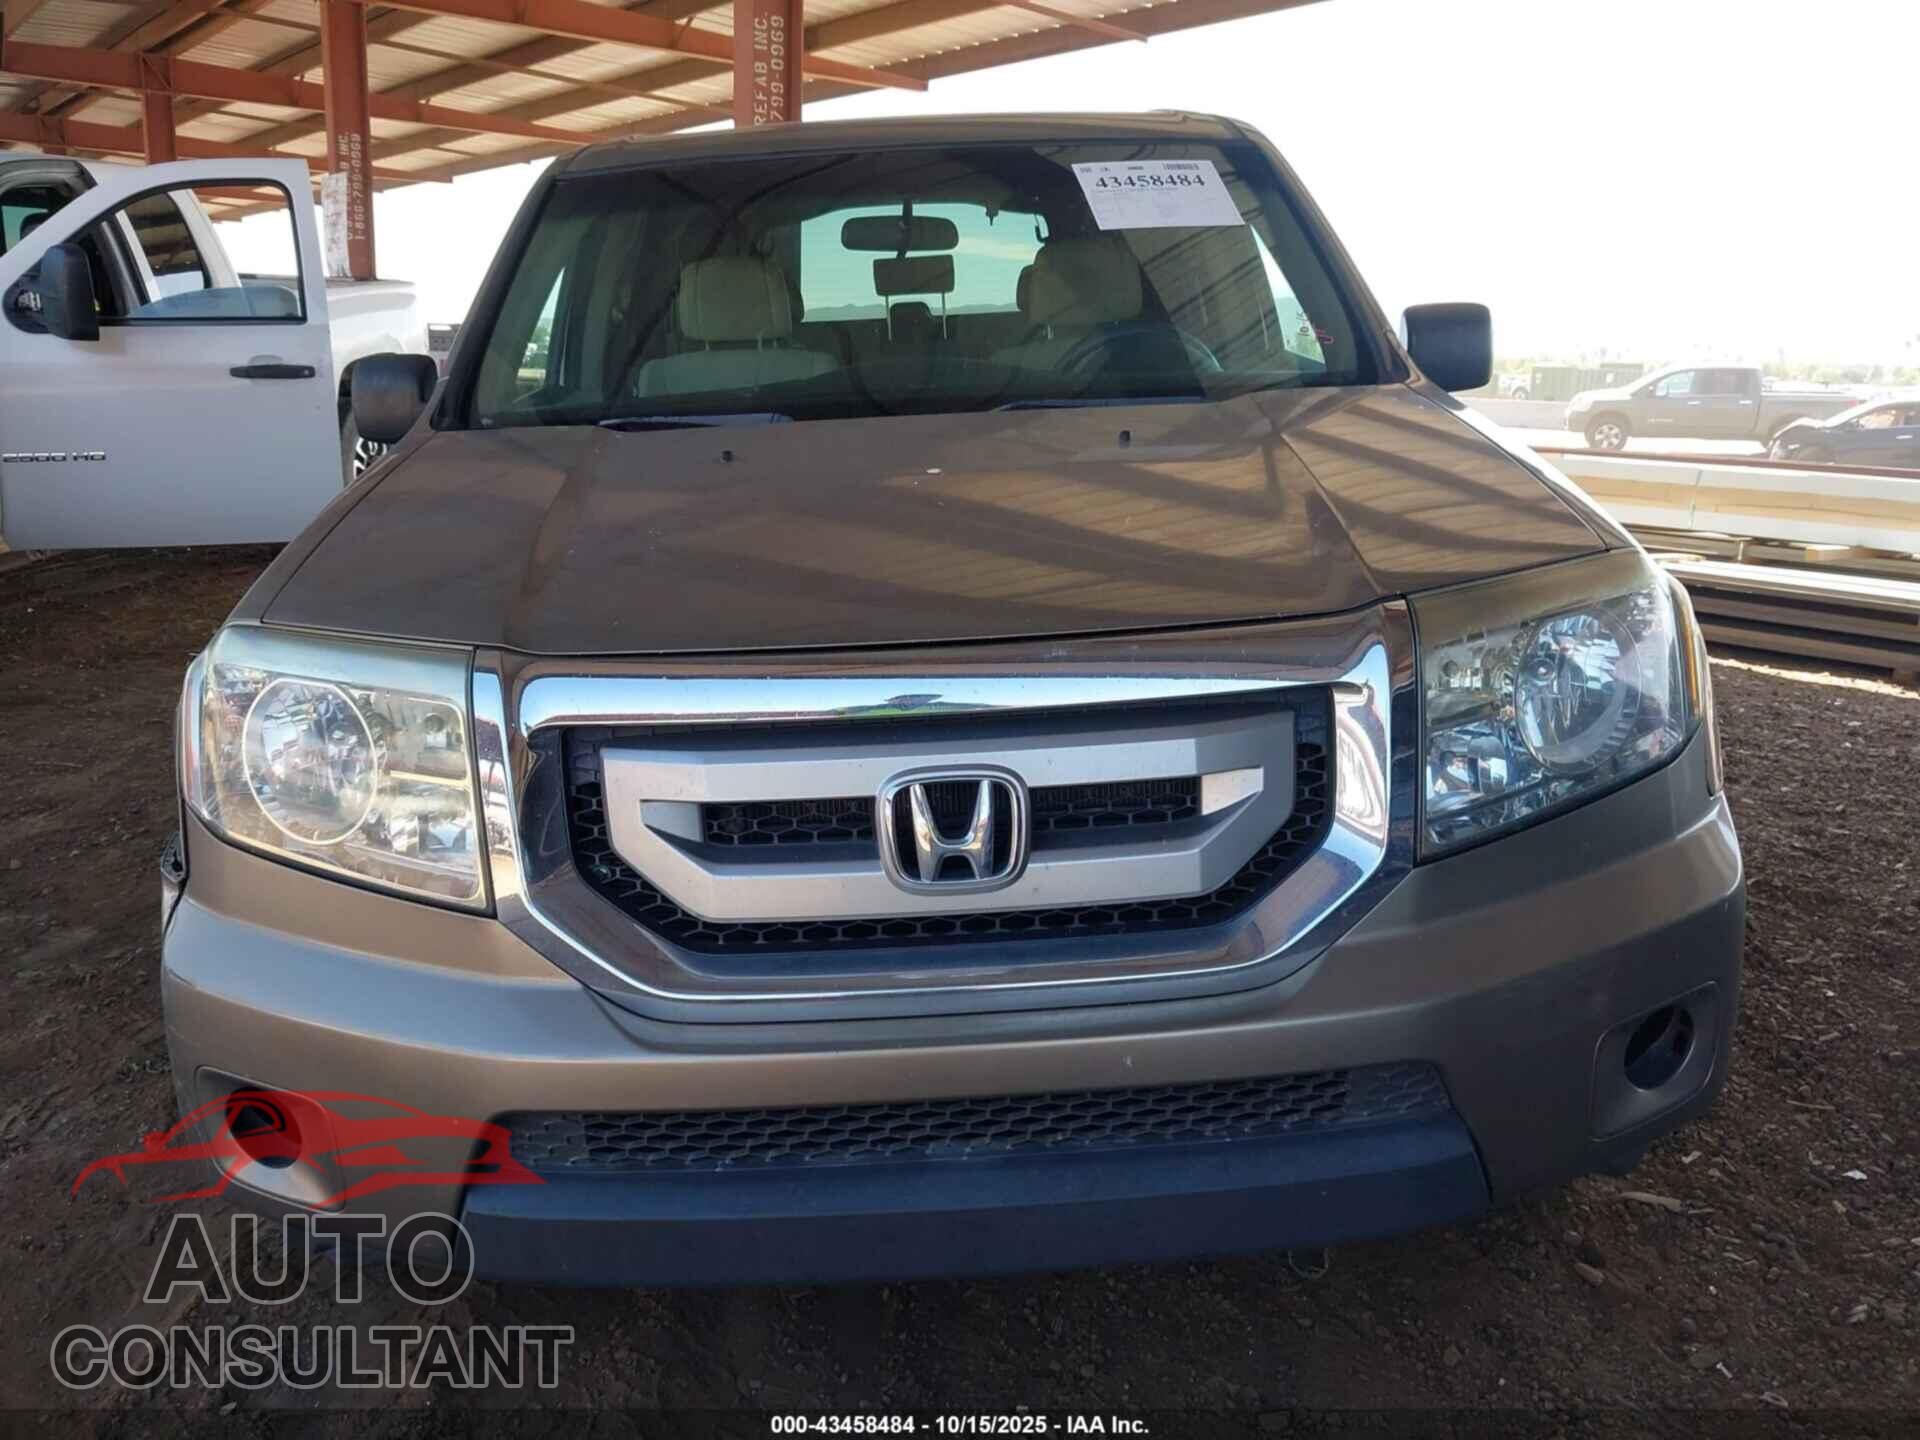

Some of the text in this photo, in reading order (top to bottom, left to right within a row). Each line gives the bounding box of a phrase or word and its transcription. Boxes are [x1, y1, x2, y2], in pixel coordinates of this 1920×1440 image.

[754, 11, 769, 51] INC.
[770, 15, 785, 121] 799-0969
[1095, 174, 1205, 188] 43458484
